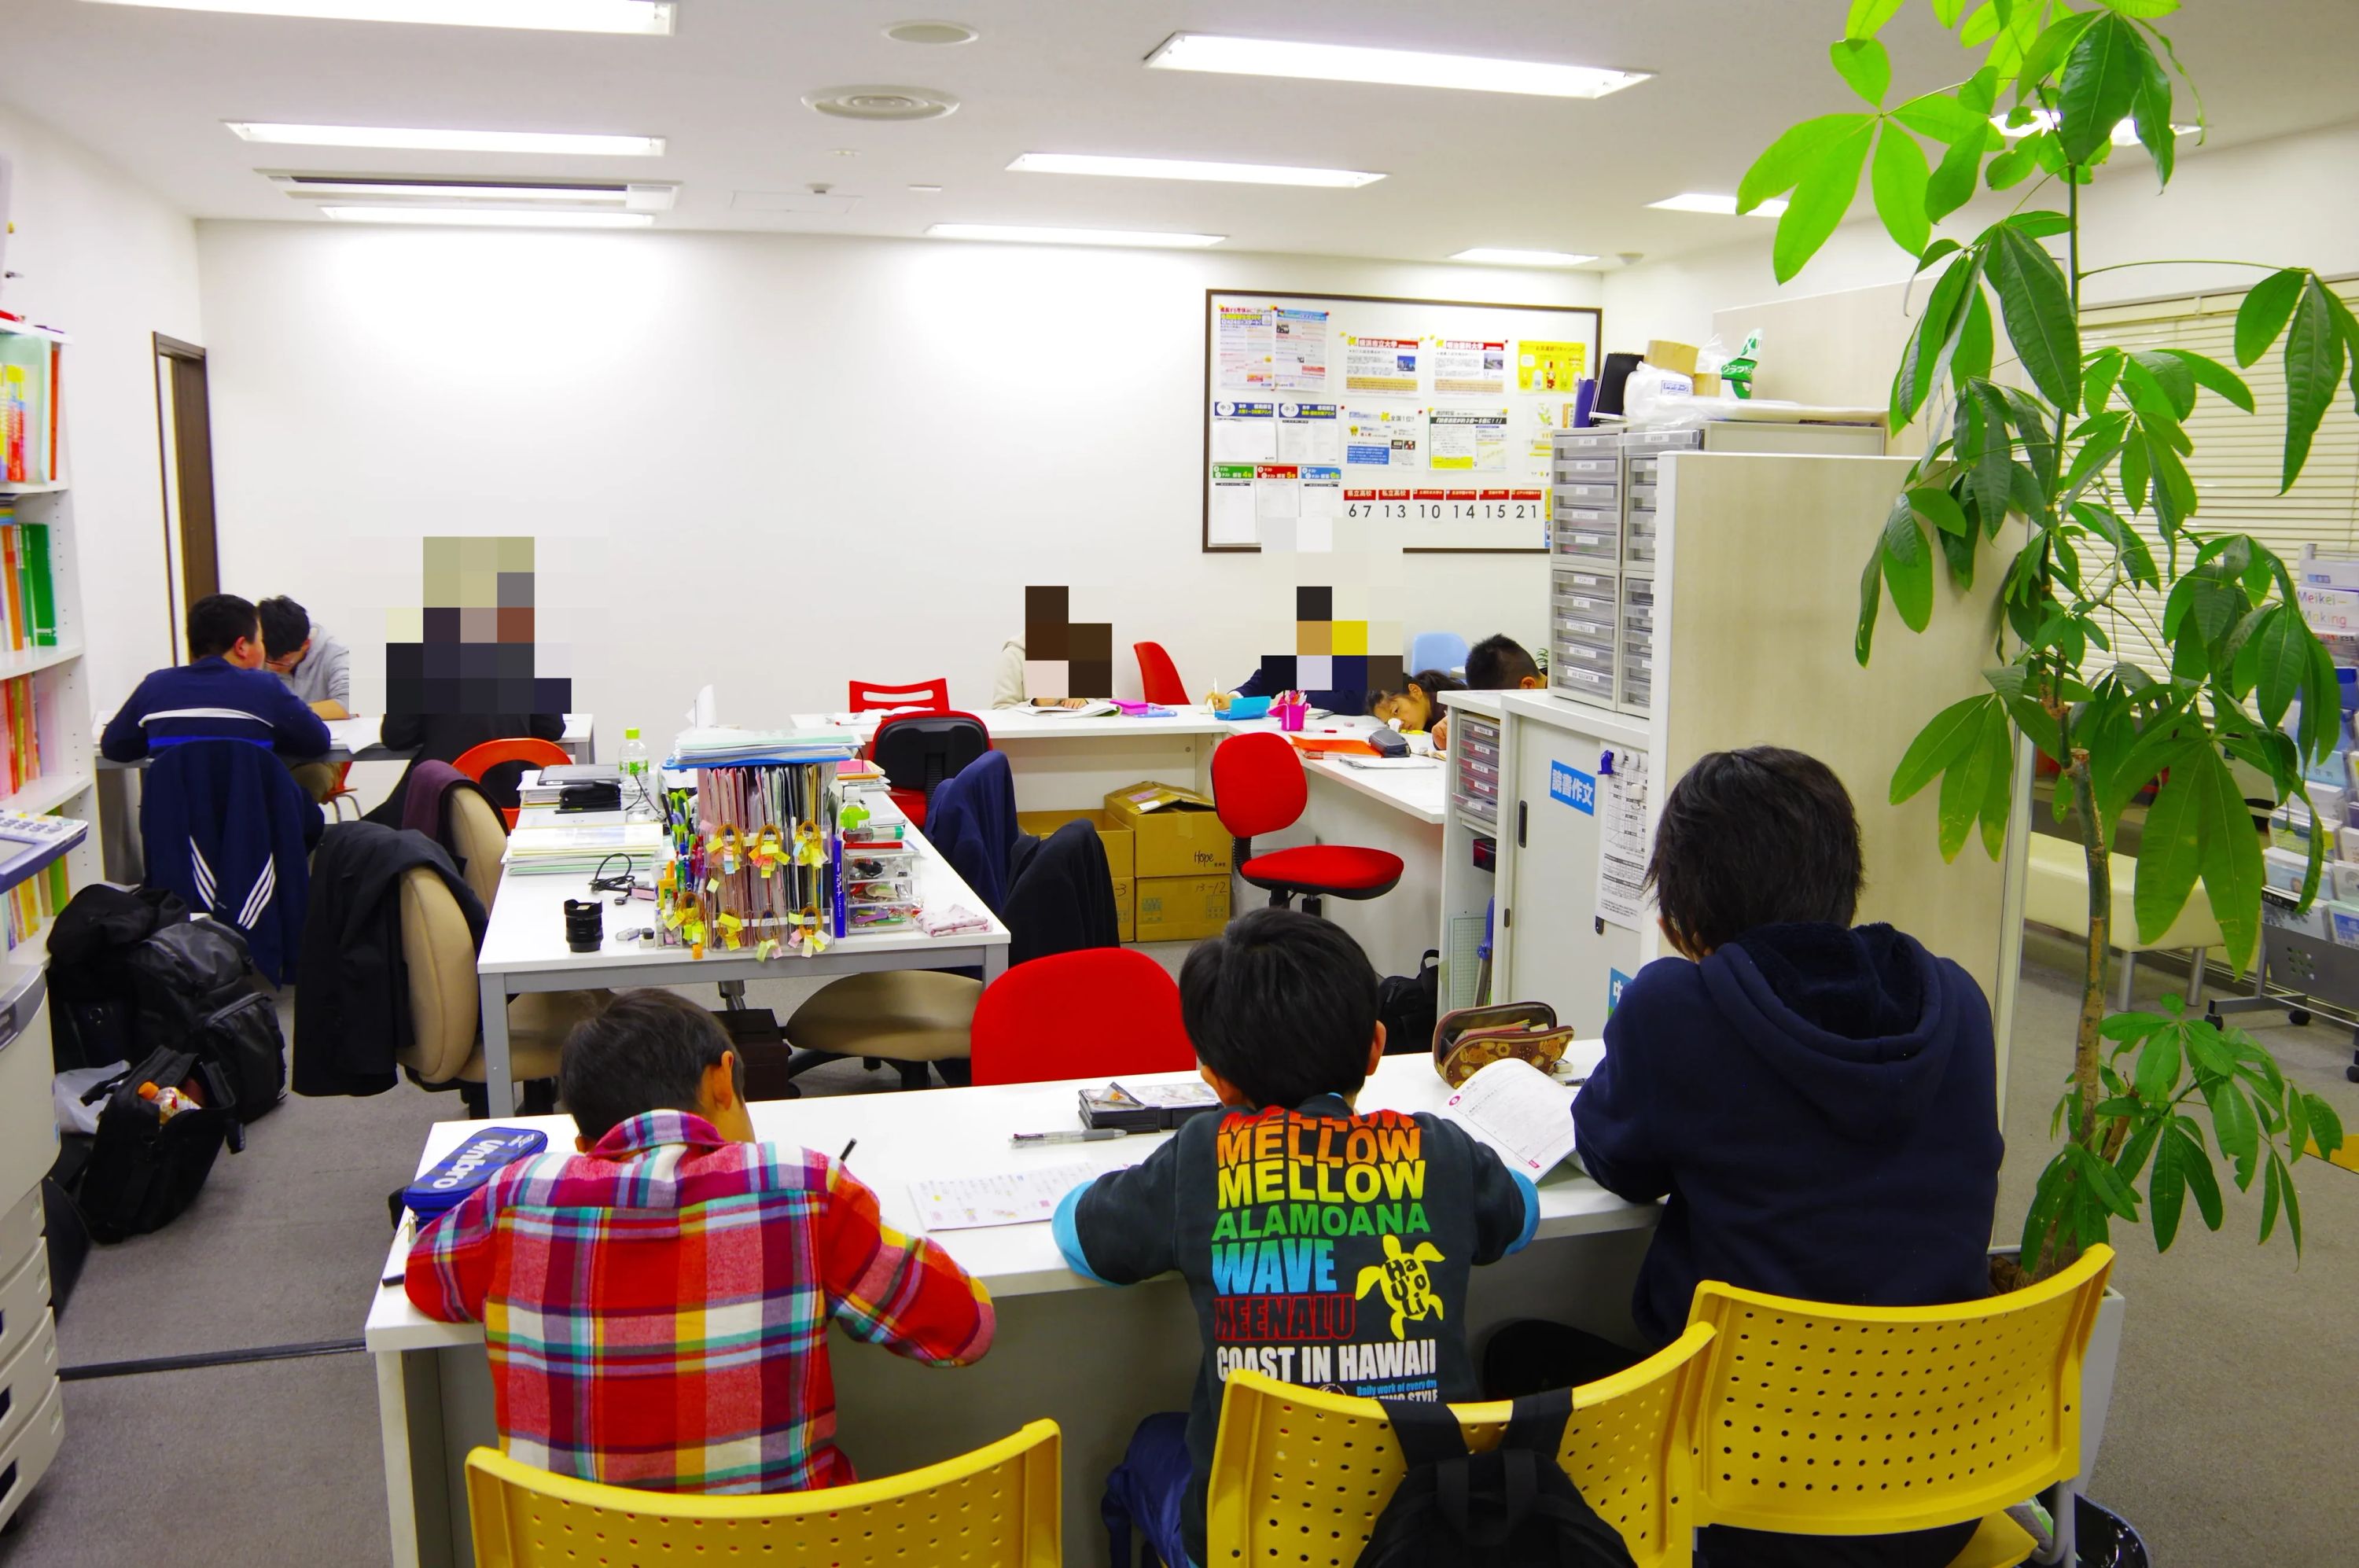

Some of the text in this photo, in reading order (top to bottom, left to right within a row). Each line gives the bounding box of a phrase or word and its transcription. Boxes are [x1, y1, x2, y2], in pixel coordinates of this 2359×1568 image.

[1194, 849, 1214, 867] Hope
[432, 1139, 506, 1189] umbro
[1217, 1124, 1421, 1170] MELLOW
[1218, 1159, 1426, 1210] MELLOW
[1211, 1202, 1431, 1241] ALAMOANA
[1212, 1237, 1338, 1295] WAVE
[1216, 1338, 1437, 1383] COAST IN HAWAII
[1356, 1379, 1437, 1397] Daily work of every day
